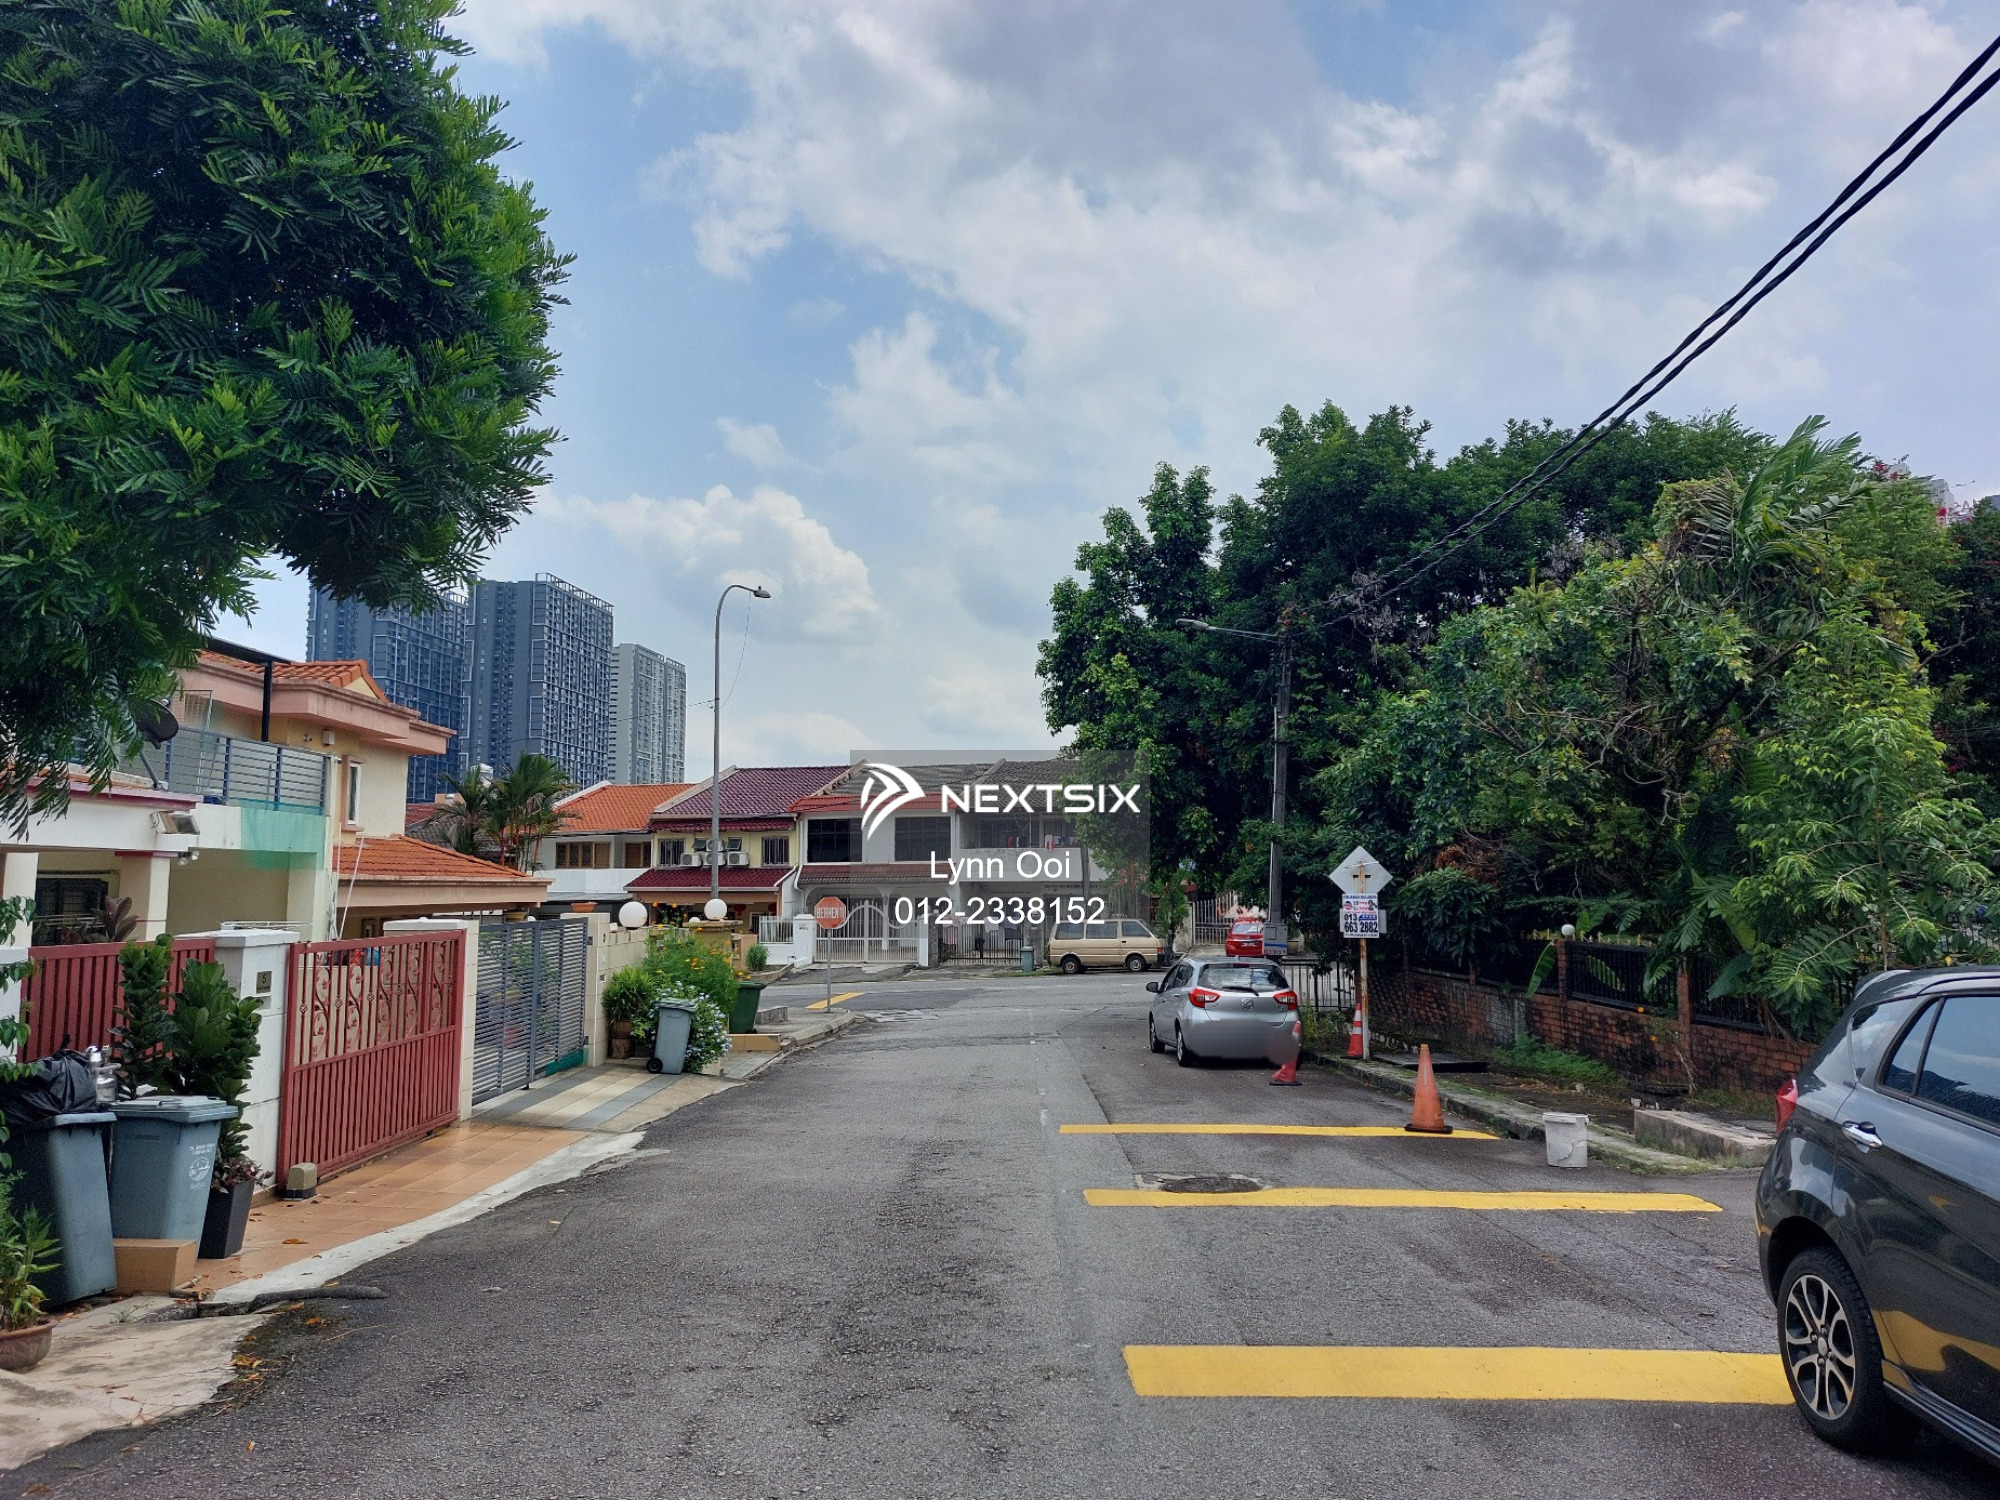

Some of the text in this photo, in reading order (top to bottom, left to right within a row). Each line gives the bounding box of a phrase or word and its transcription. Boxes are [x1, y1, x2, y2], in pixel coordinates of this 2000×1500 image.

[1344, 922, 1378, 932] 663 2882
[262, 973, 266, 983] 5
